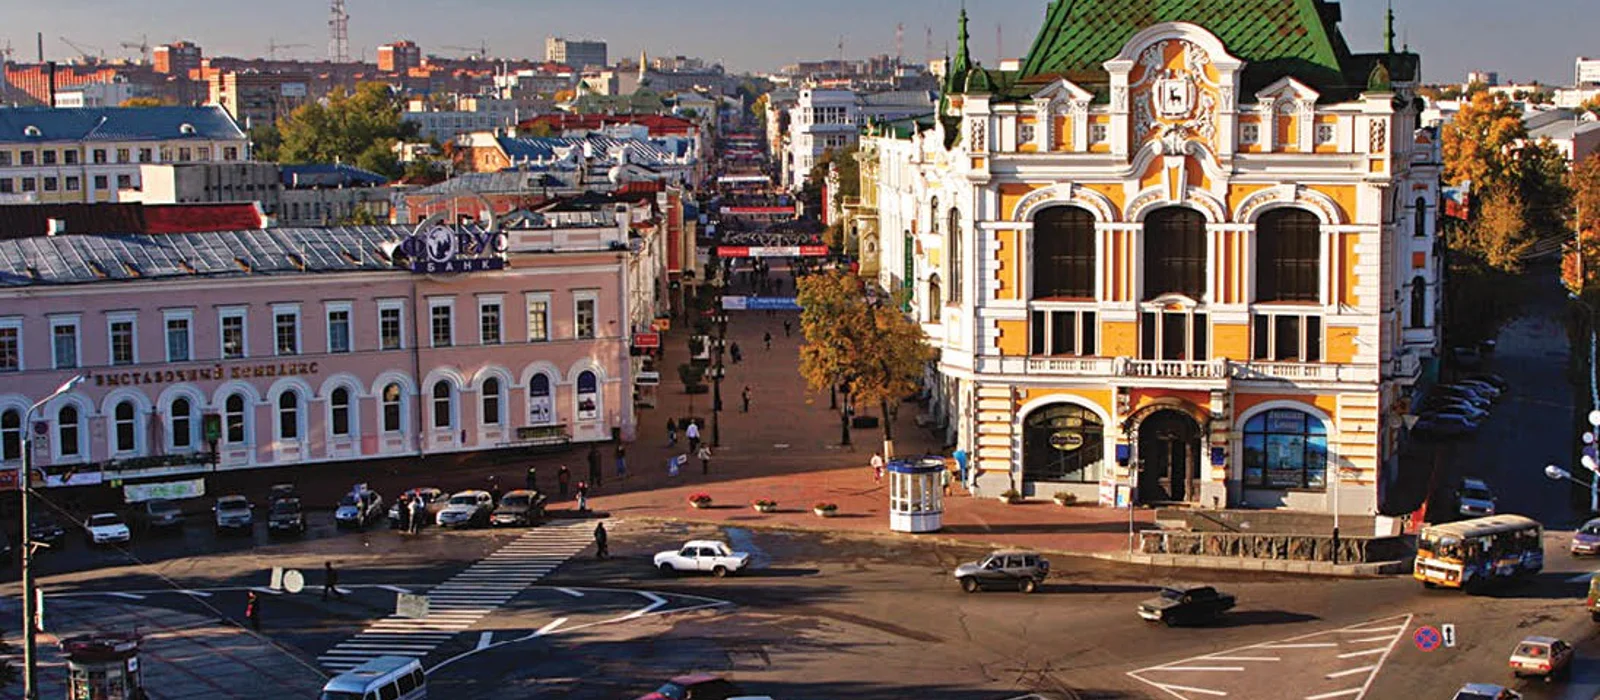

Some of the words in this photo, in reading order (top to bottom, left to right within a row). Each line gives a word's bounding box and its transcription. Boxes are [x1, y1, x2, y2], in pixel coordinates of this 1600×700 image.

[426, 261, 490, 272] БАНК
[95, 364, 223, 386] ВЫСТАВОЧНЫЙ
[231, 362, 319, 379] КОМПЛЕКС
